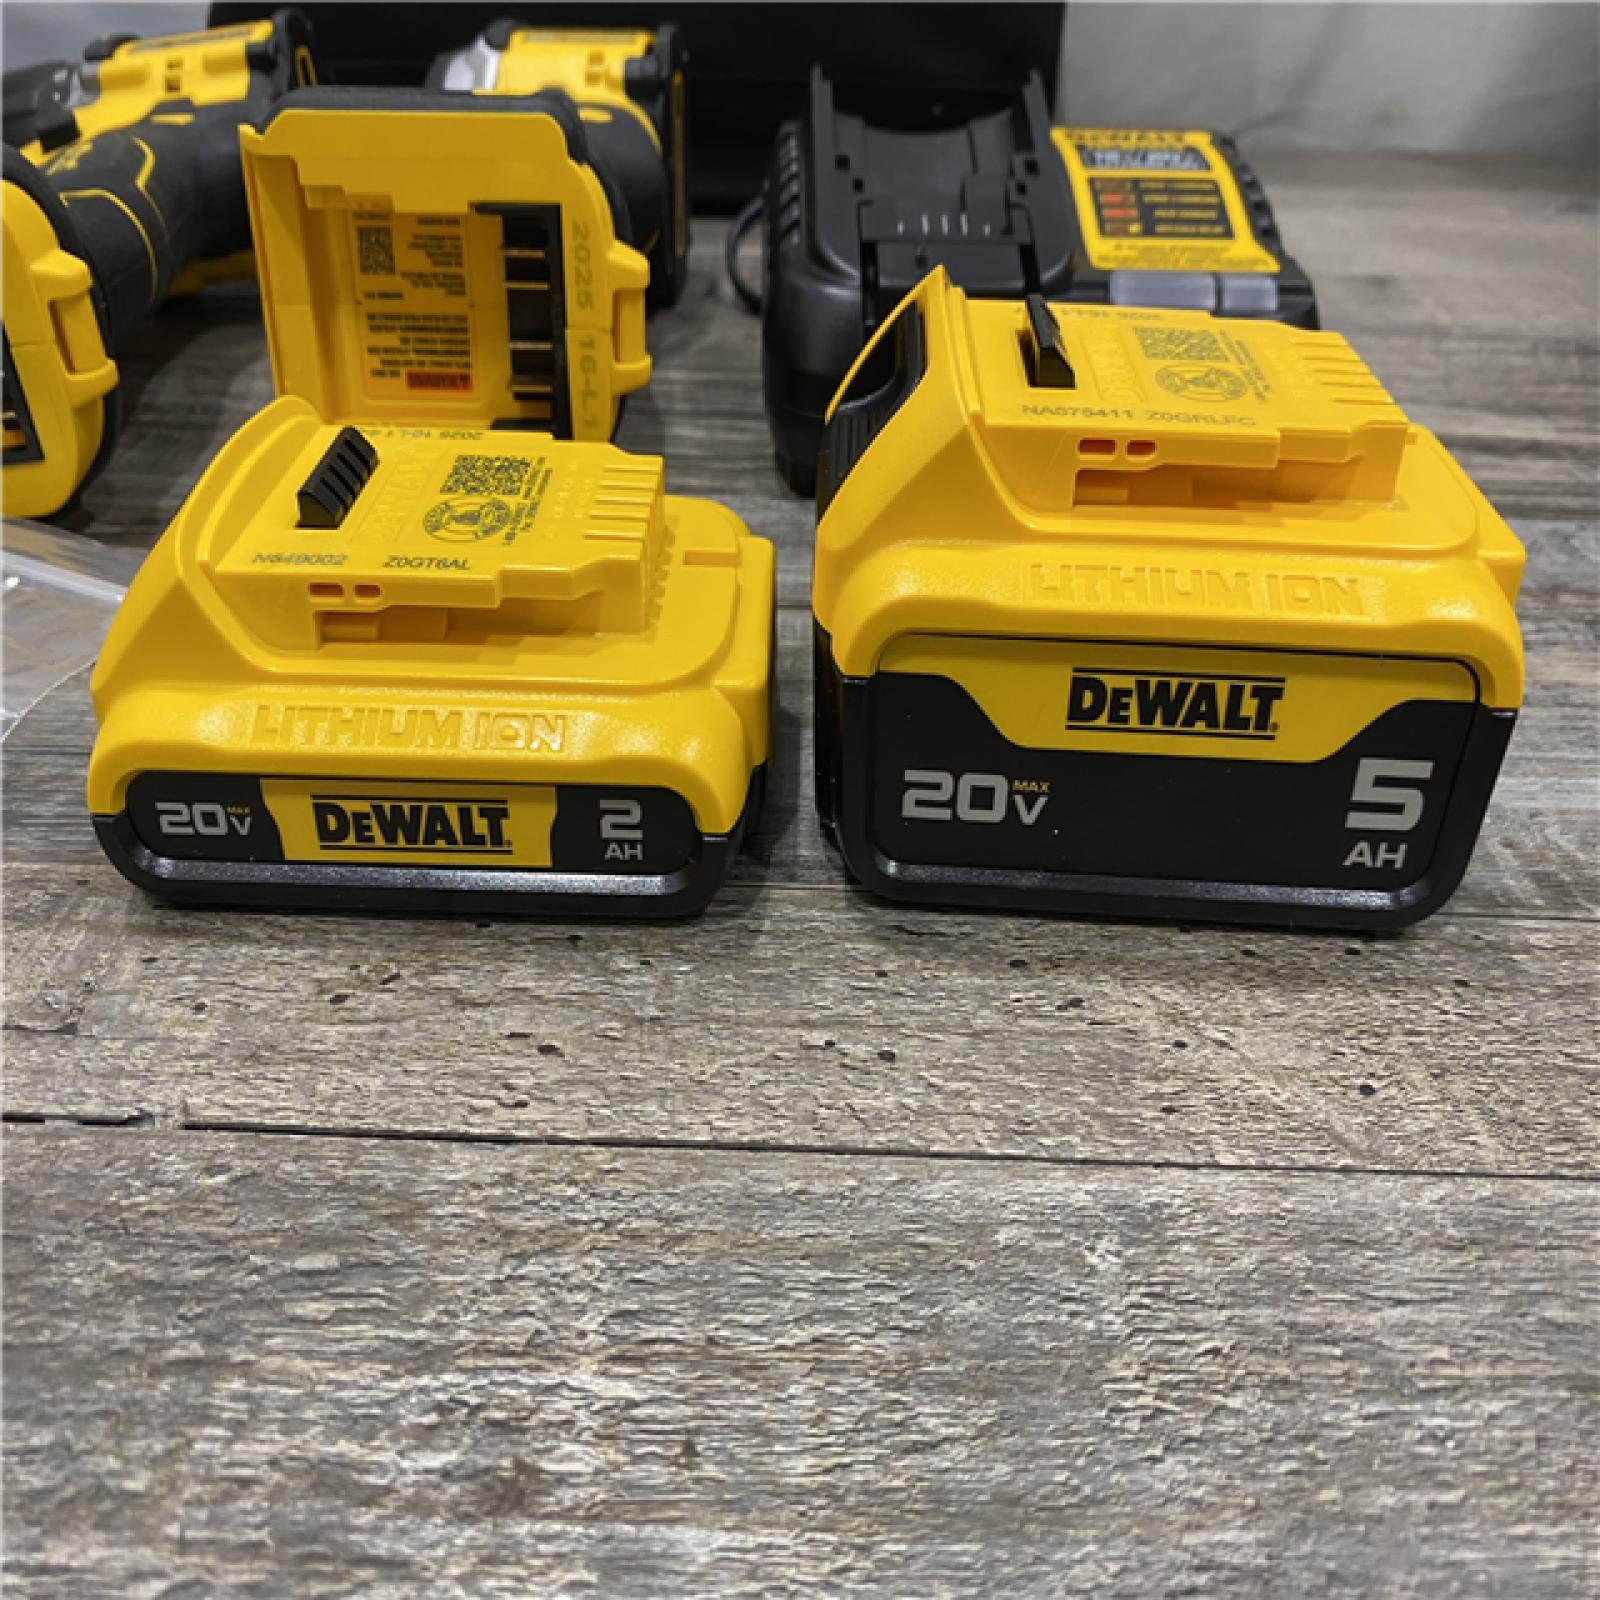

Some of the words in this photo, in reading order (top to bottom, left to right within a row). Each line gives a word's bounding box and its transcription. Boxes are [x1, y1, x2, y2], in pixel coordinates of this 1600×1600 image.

[573, 221, 593, 311] 2025
[1029, 564, 1250, 612] LITHIUM
[1262, 575, 1366, 616] ION
[251, 703, 464, 750] LITHIUM
[472, 711, 567, 752] ION
[1013, 779, 1051, 793] MAX
[1346, 757, 1434, 831] 5
[599, 800, 643, 840] 2
[605, 842, 643, 861] AH
[1342, 841, 1408, 869] AH
